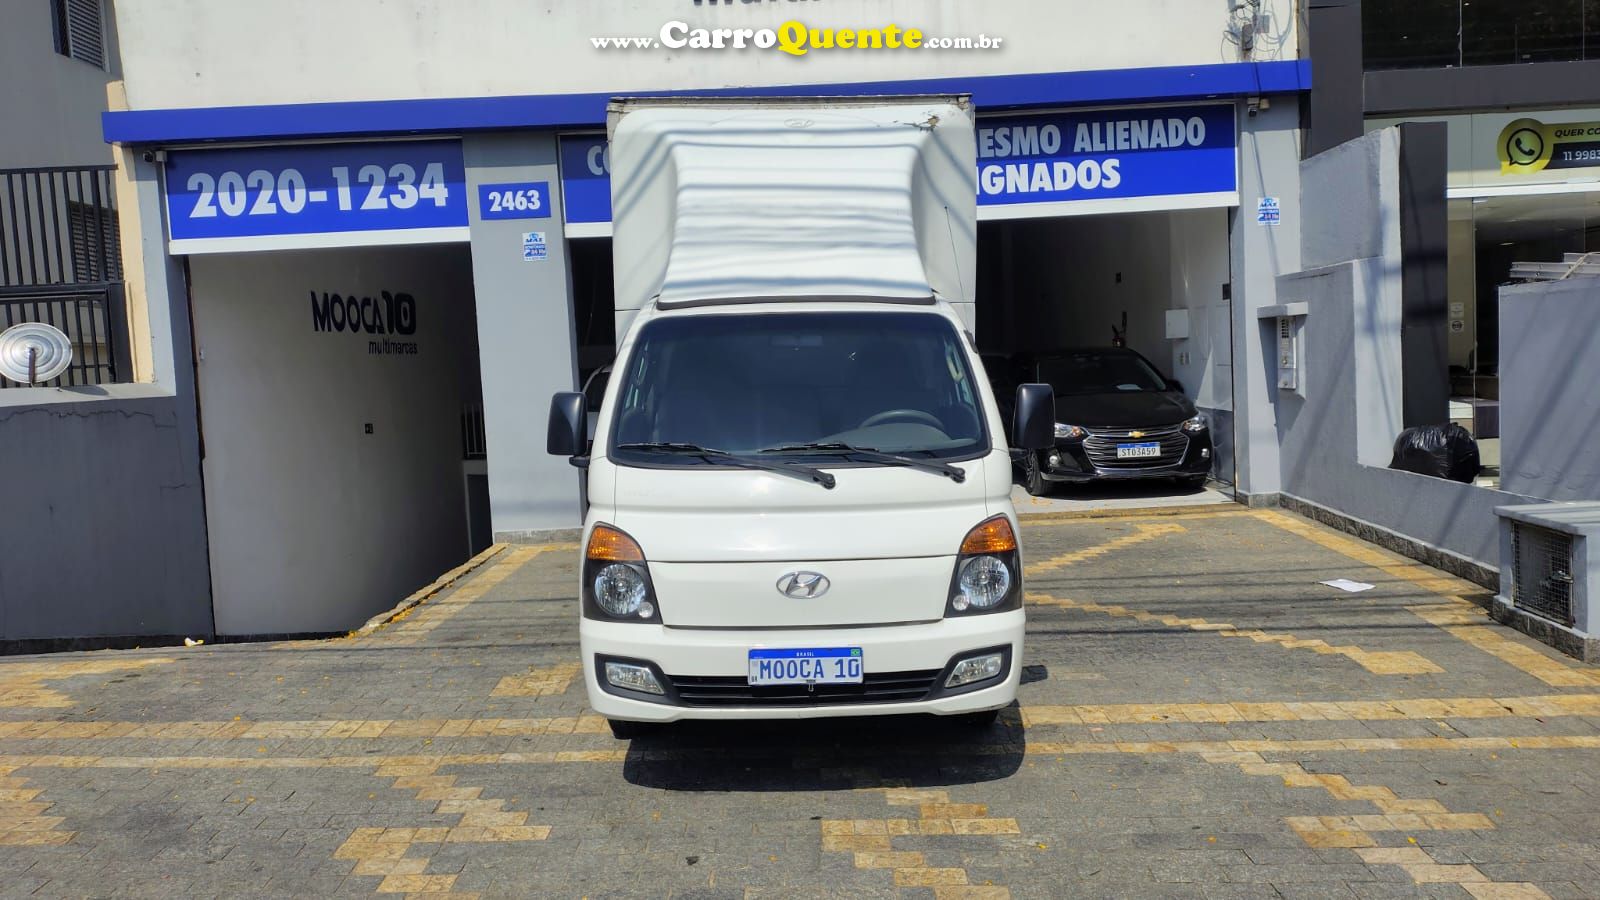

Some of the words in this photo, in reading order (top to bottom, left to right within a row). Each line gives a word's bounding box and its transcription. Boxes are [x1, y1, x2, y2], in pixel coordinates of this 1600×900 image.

[976, 124, 1061, 158] ESMO
[1073, 116, 1206, 153] ALIENADO
[1554, 129, 1584, 138] QUER
[1563, 151, 1572, 161] 11
[186, 162, 449, 218] 2020-1234
[488, 190, 541, 212] 2463
[368, 338, 418, 355] multimarcas
[759, 659, 824, 679] MOOCA
